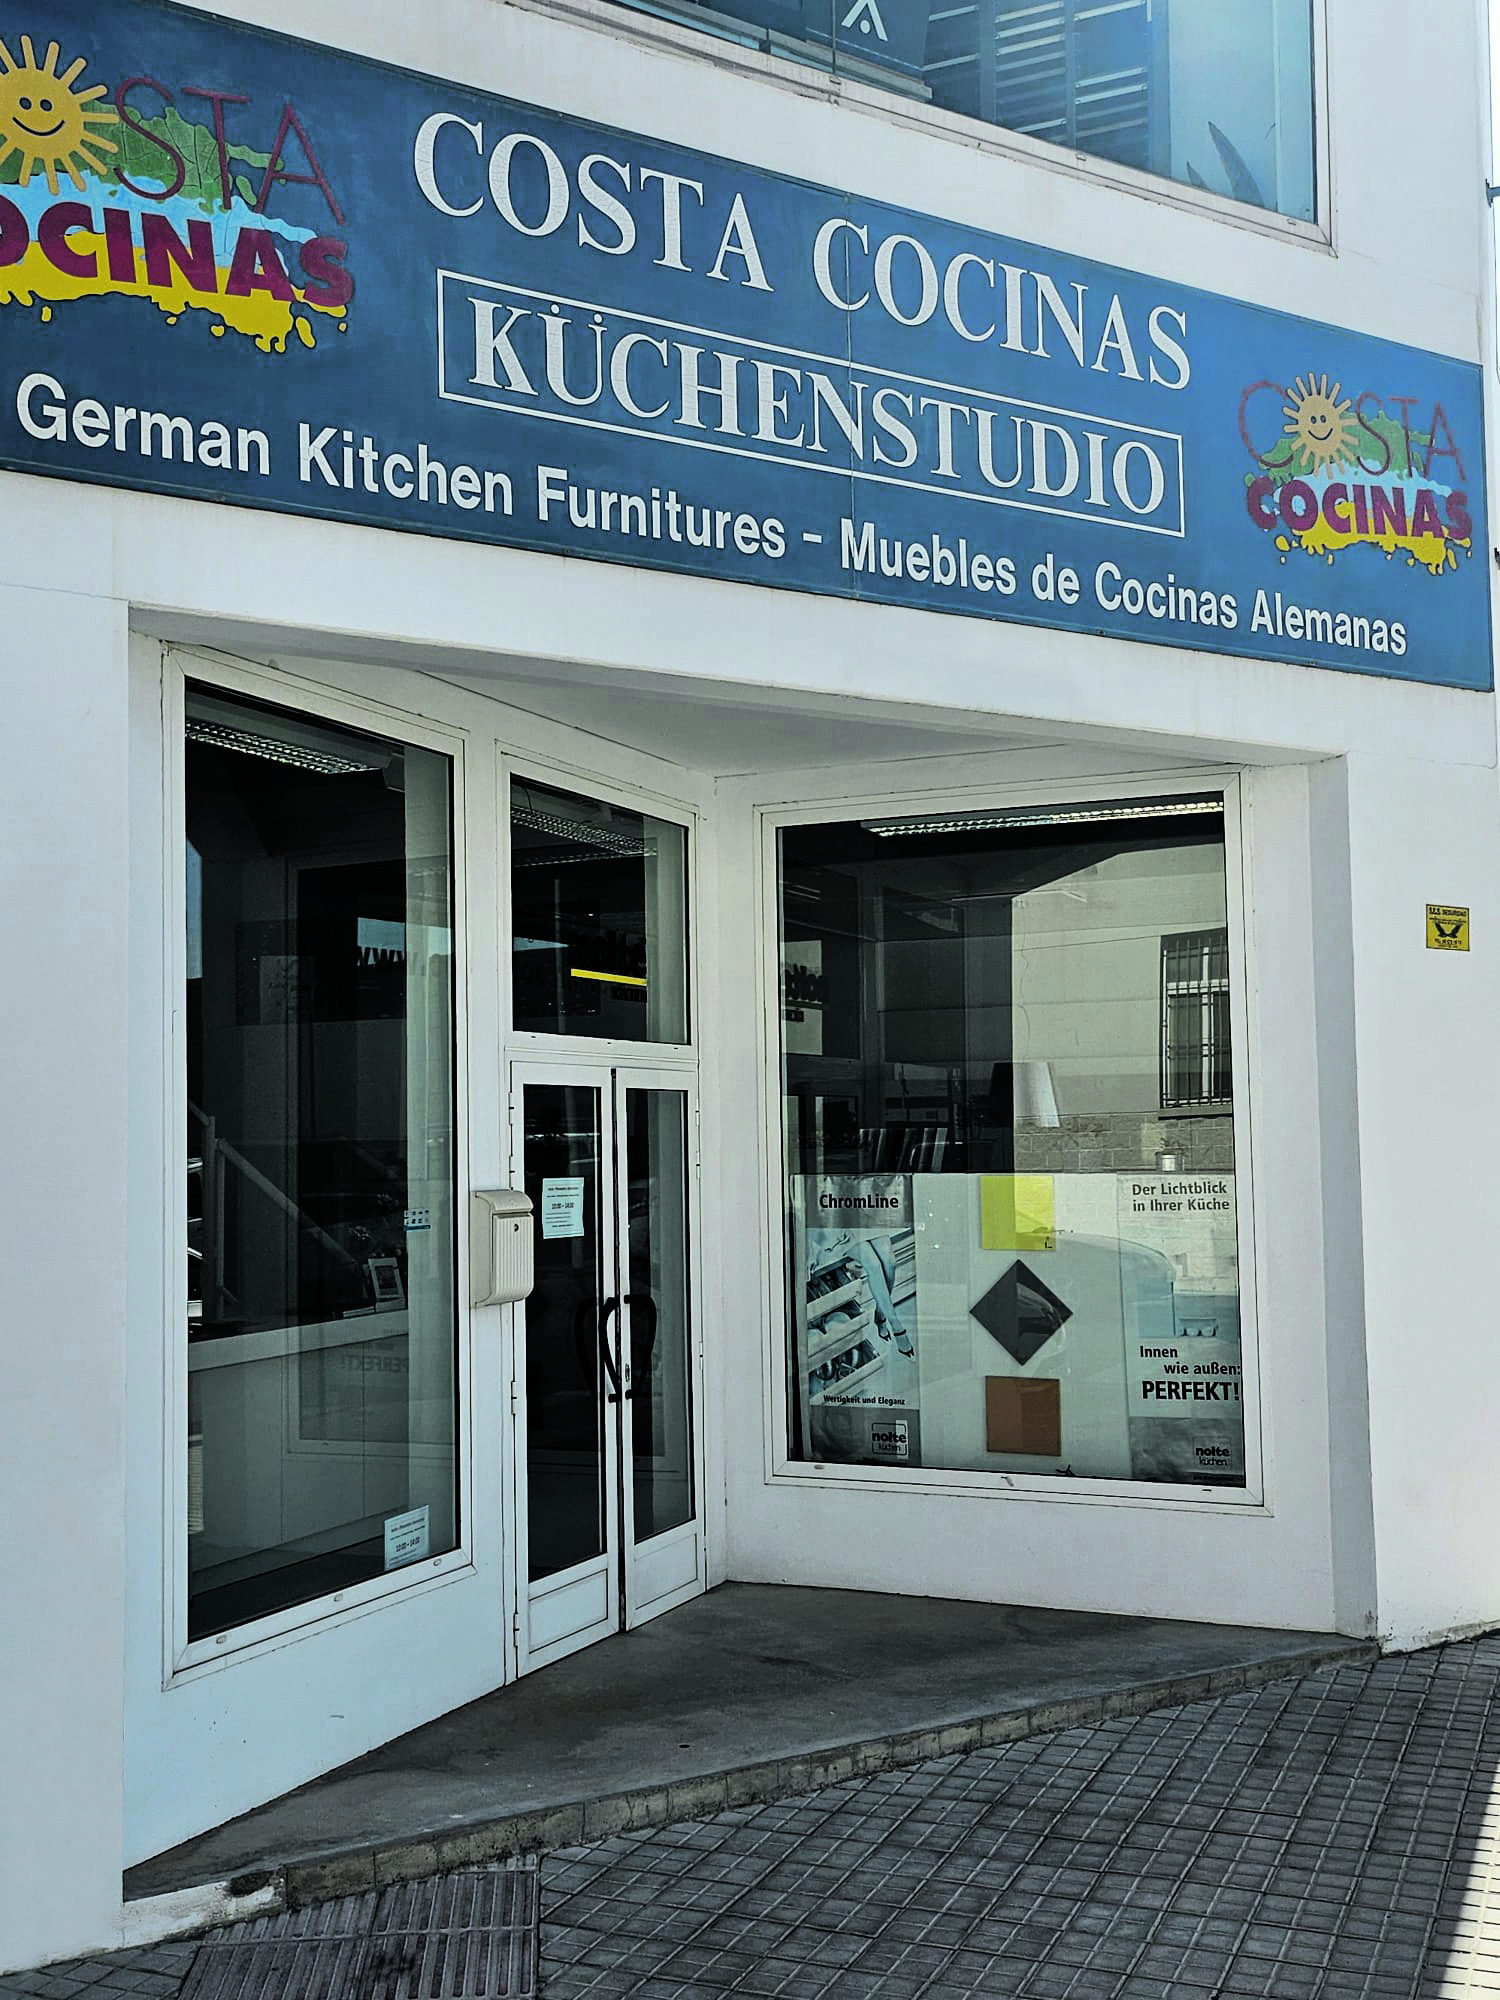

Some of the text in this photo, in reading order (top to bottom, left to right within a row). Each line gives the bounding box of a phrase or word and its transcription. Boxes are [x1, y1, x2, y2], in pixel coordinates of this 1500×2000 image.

[413, 111, 1191, 390] COSTA COCINAS
[467, 297, 1166, 515] KÜCHENSTUDIO
[16, 372, 271, 476] German
[299, 422, 513, 516] Kitchen
[537, 465, 787, 559] Furnitures
[840, 517, 1017, 596] Muebles
[1032, 553, 1080, 605] de
[1095, 561, 1238, 630] Cocinas
[1249, 589, 1408, 657] Alemanas
[1247, 476, 1472, 540] COCINAS
[1132, 1181, 1228, 1195] Der Lichtblick
[819, 1193, 900, 1209] ChromLine
[1133, 1198, 1230, 1211] in Ihrer Küche
[1139, 1345, 1179, 1358] Innen
[1163, 1361, 1241, 1375] wie außen:
[1141, 1380, 1240, 1400] PERFEKT!
[823, 1395, 906, 1406] Wertigkeit und Eleganz
[871, 1431, 907, 1443] nolte
[1195, 1446, 1230, 1457] nolte
